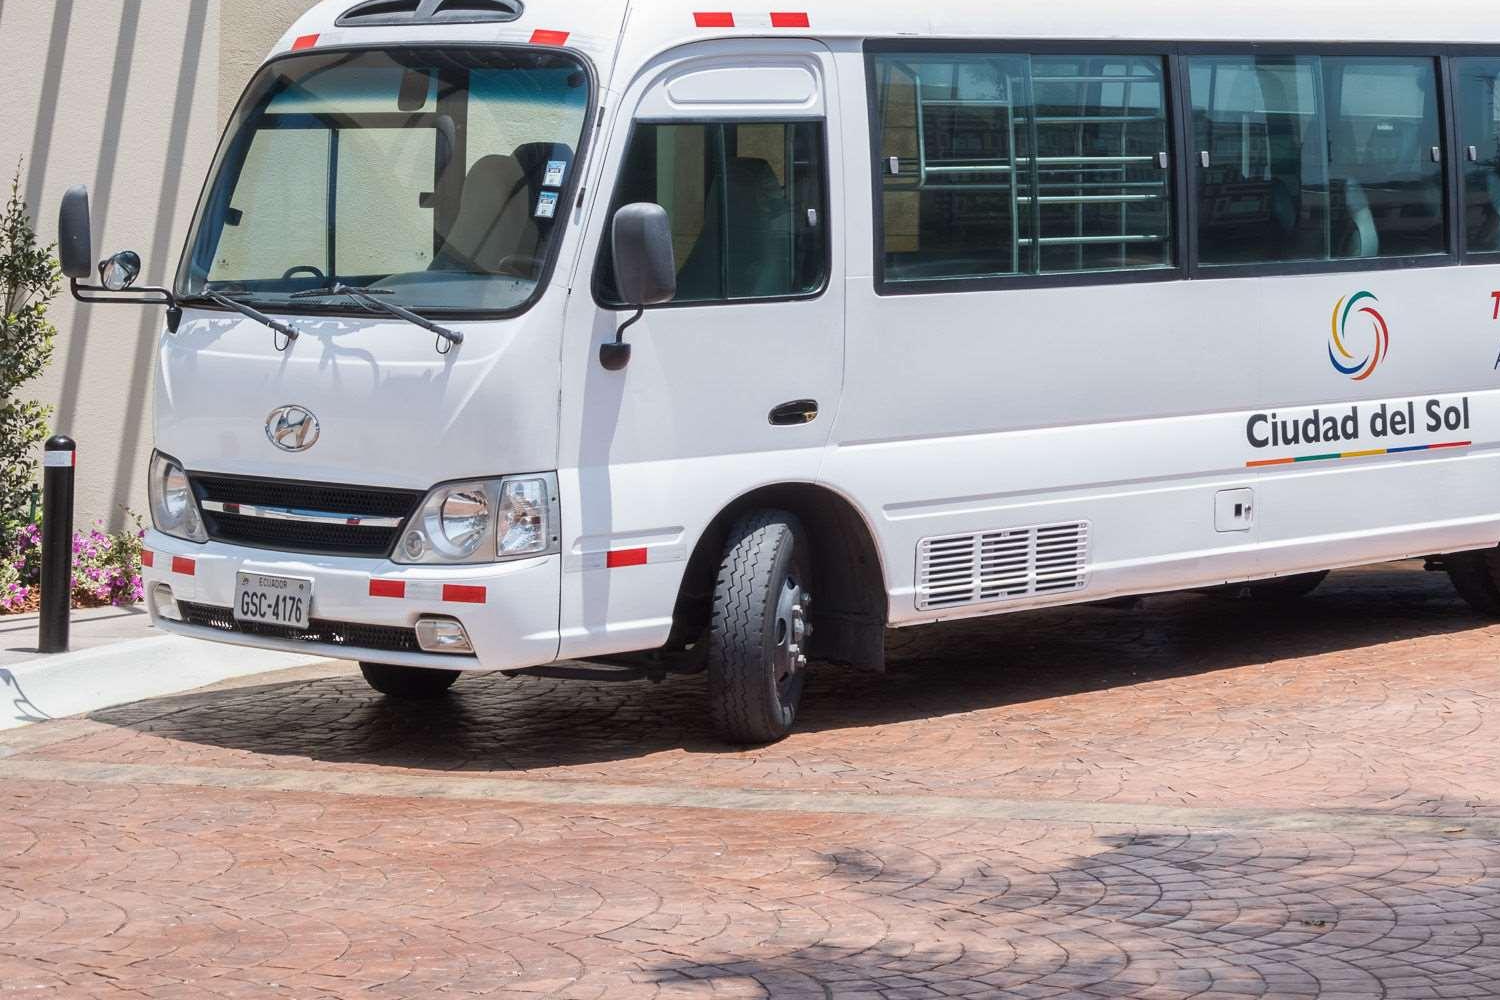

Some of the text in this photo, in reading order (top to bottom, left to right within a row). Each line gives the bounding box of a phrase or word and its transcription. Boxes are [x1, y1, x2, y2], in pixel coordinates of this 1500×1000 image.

[1246, 398, 1471, 448] Ciudad del Sol
[259, 578, 288, 589] ECUADOR
[241, 591, 302, 622] GSC-4176
